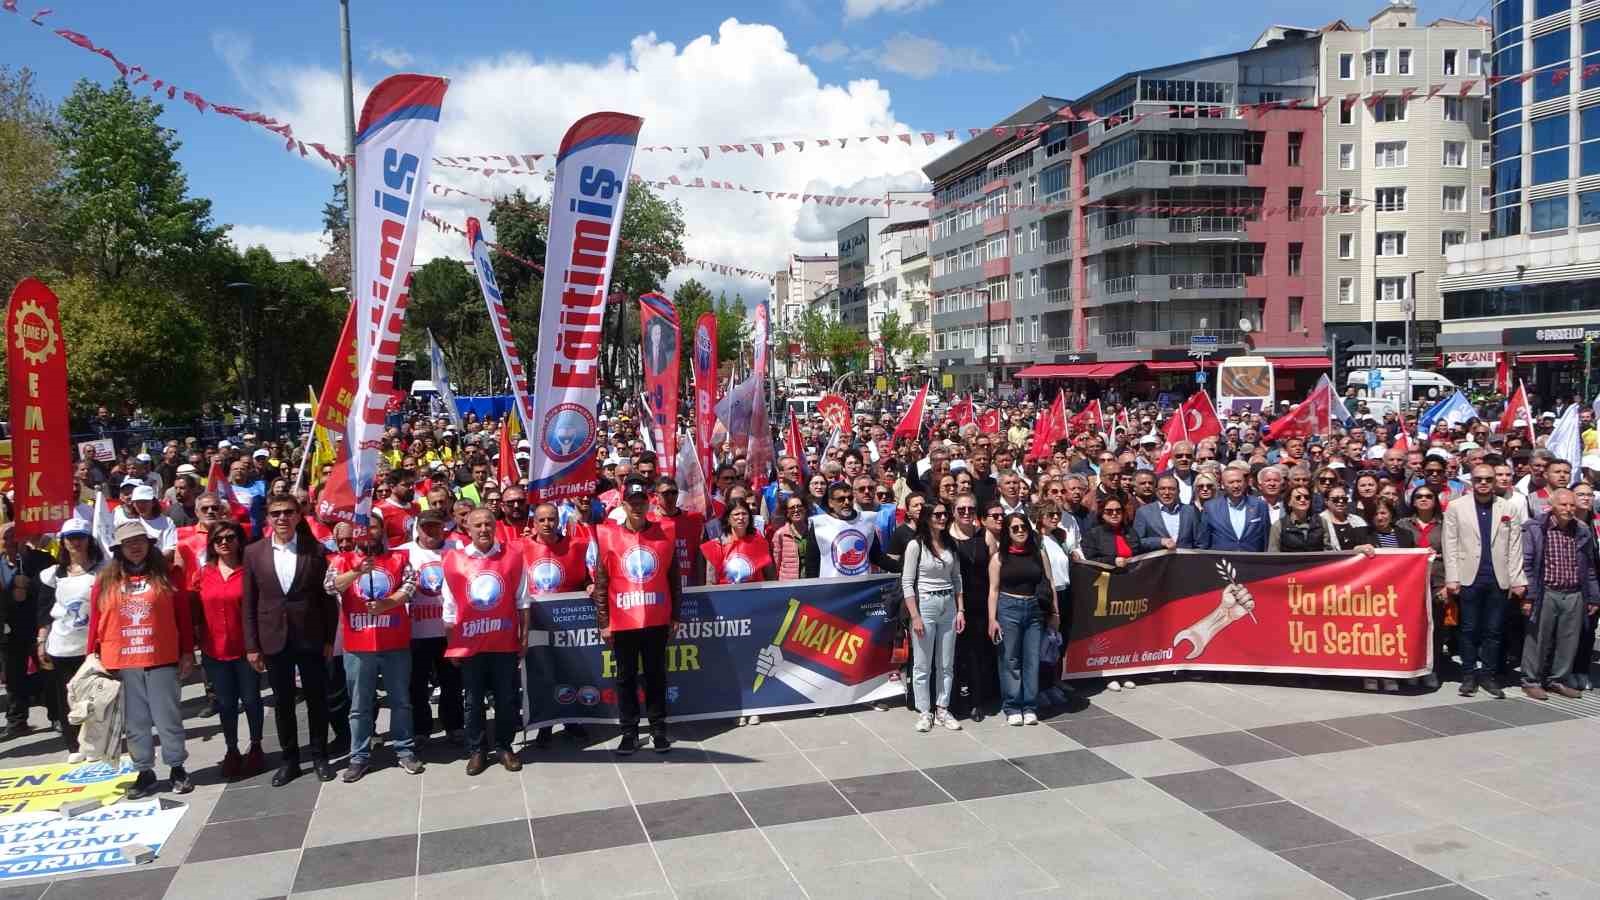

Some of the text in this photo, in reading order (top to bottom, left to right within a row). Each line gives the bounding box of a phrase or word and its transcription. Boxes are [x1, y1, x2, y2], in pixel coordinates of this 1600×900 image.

[1450, 351, 1494, 363] ECZANE
[1093, 571, 1110, 617] 1
[1322, 584, 1399, 618] Adalet
[674, 615, 752, 641] RÜSÜNE
